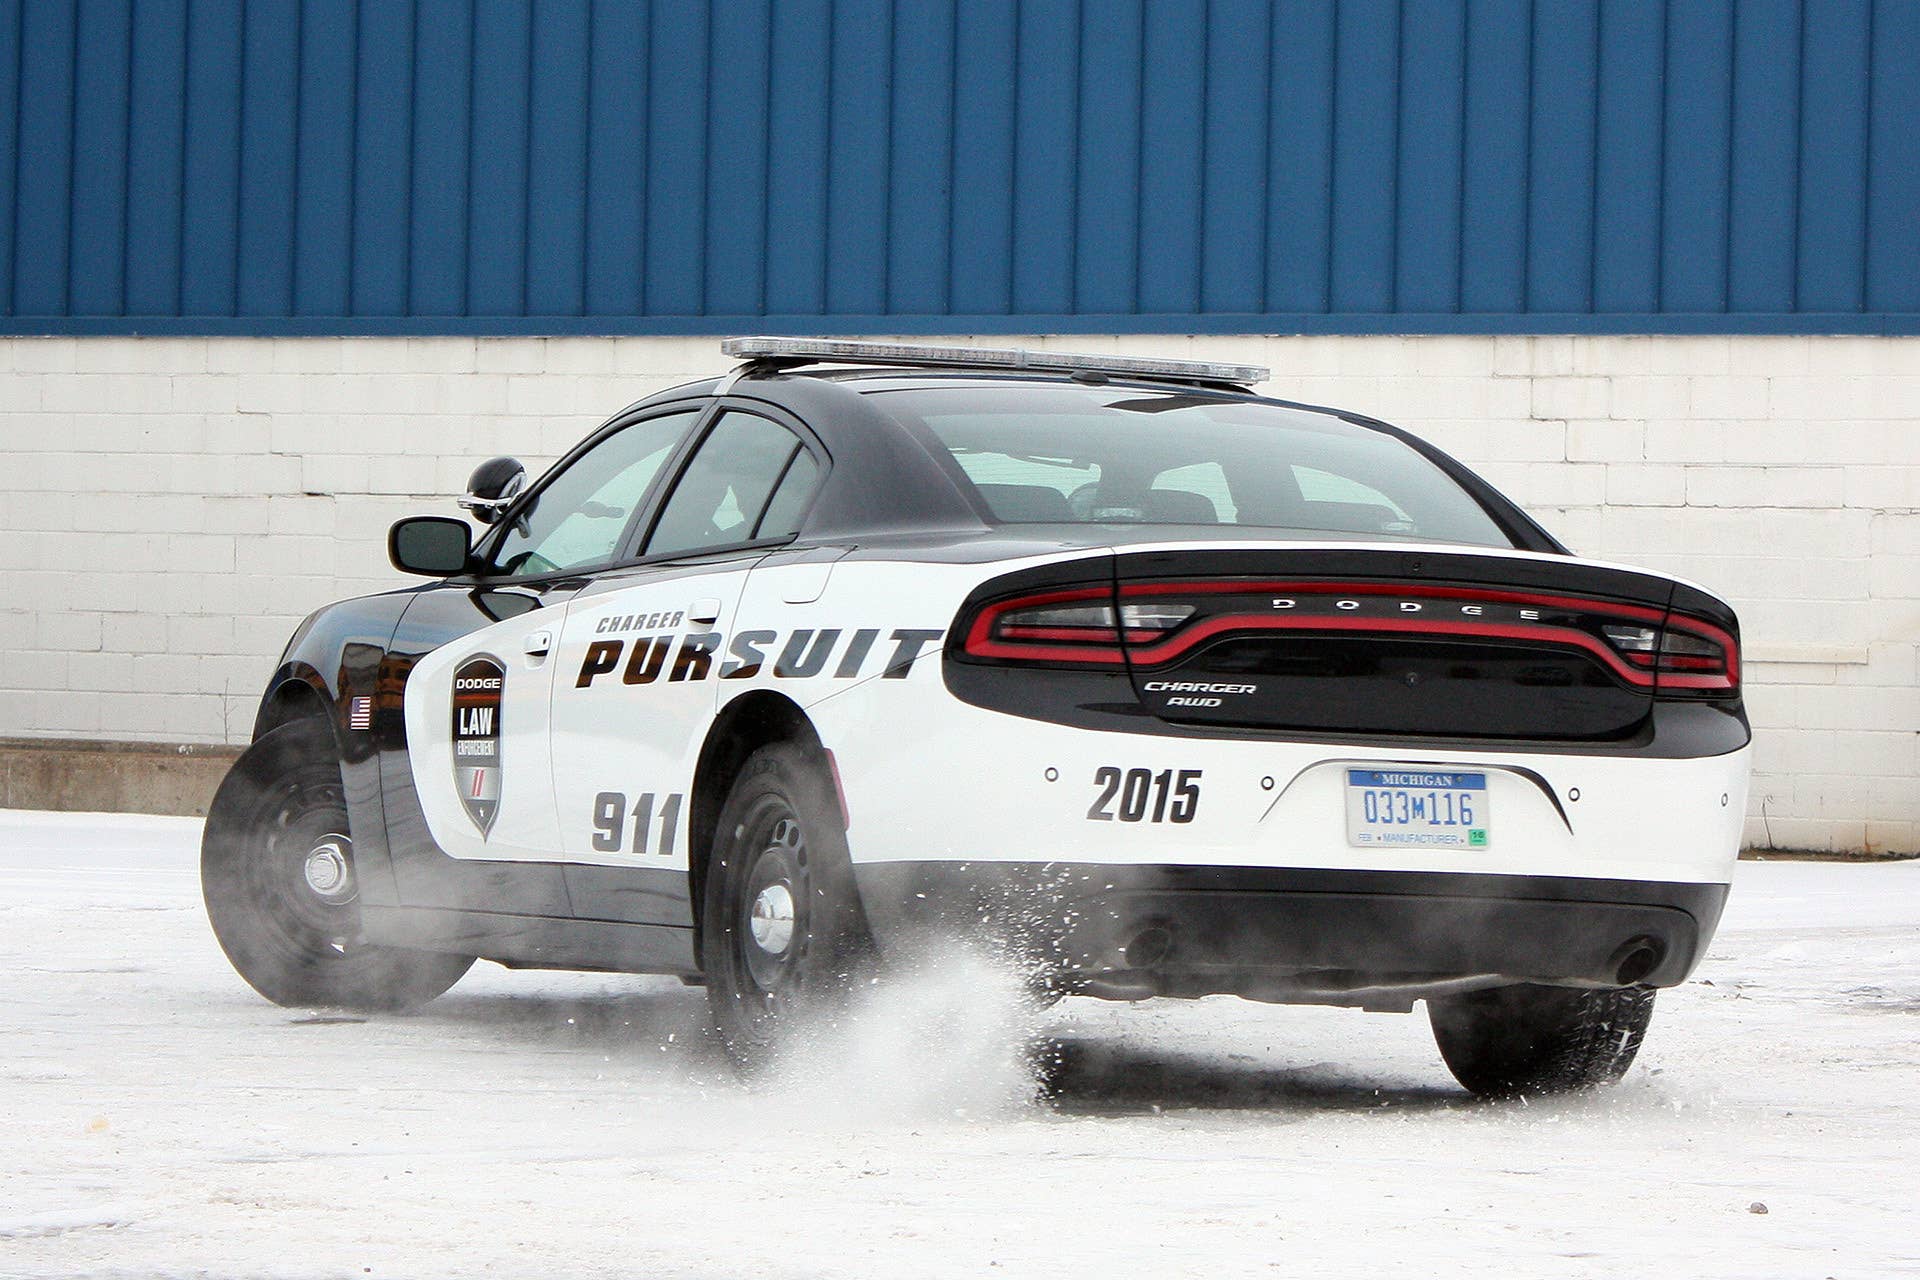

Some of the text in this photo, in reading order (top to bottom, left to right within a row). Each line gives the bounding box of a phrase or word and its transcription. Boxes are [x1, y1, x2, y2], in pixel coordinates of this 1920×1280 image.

[1273, 599, 1541, 620] DODGE
[595, 610, 685, 633] CHARGER
[575, 629, 946, 688] PURSUIT
[455, 678, 502, 690] DODGE
[1144, 681, 1257, 695] CHARGER
[1167, 697, 1223, 708] AWD
[459, 707, 494, 736] LAW
[457, 740, 495, 756] ENFORCEMENT
[1382, 774, 1453, 786] MICHIGAN
[1086, 766, 1203, 824] 2015
[1364, 790, 1473, 826] 033M116
[592, 792, 683, 855] 911
[1383, 833, 1459, 845] MANUFACTURER
